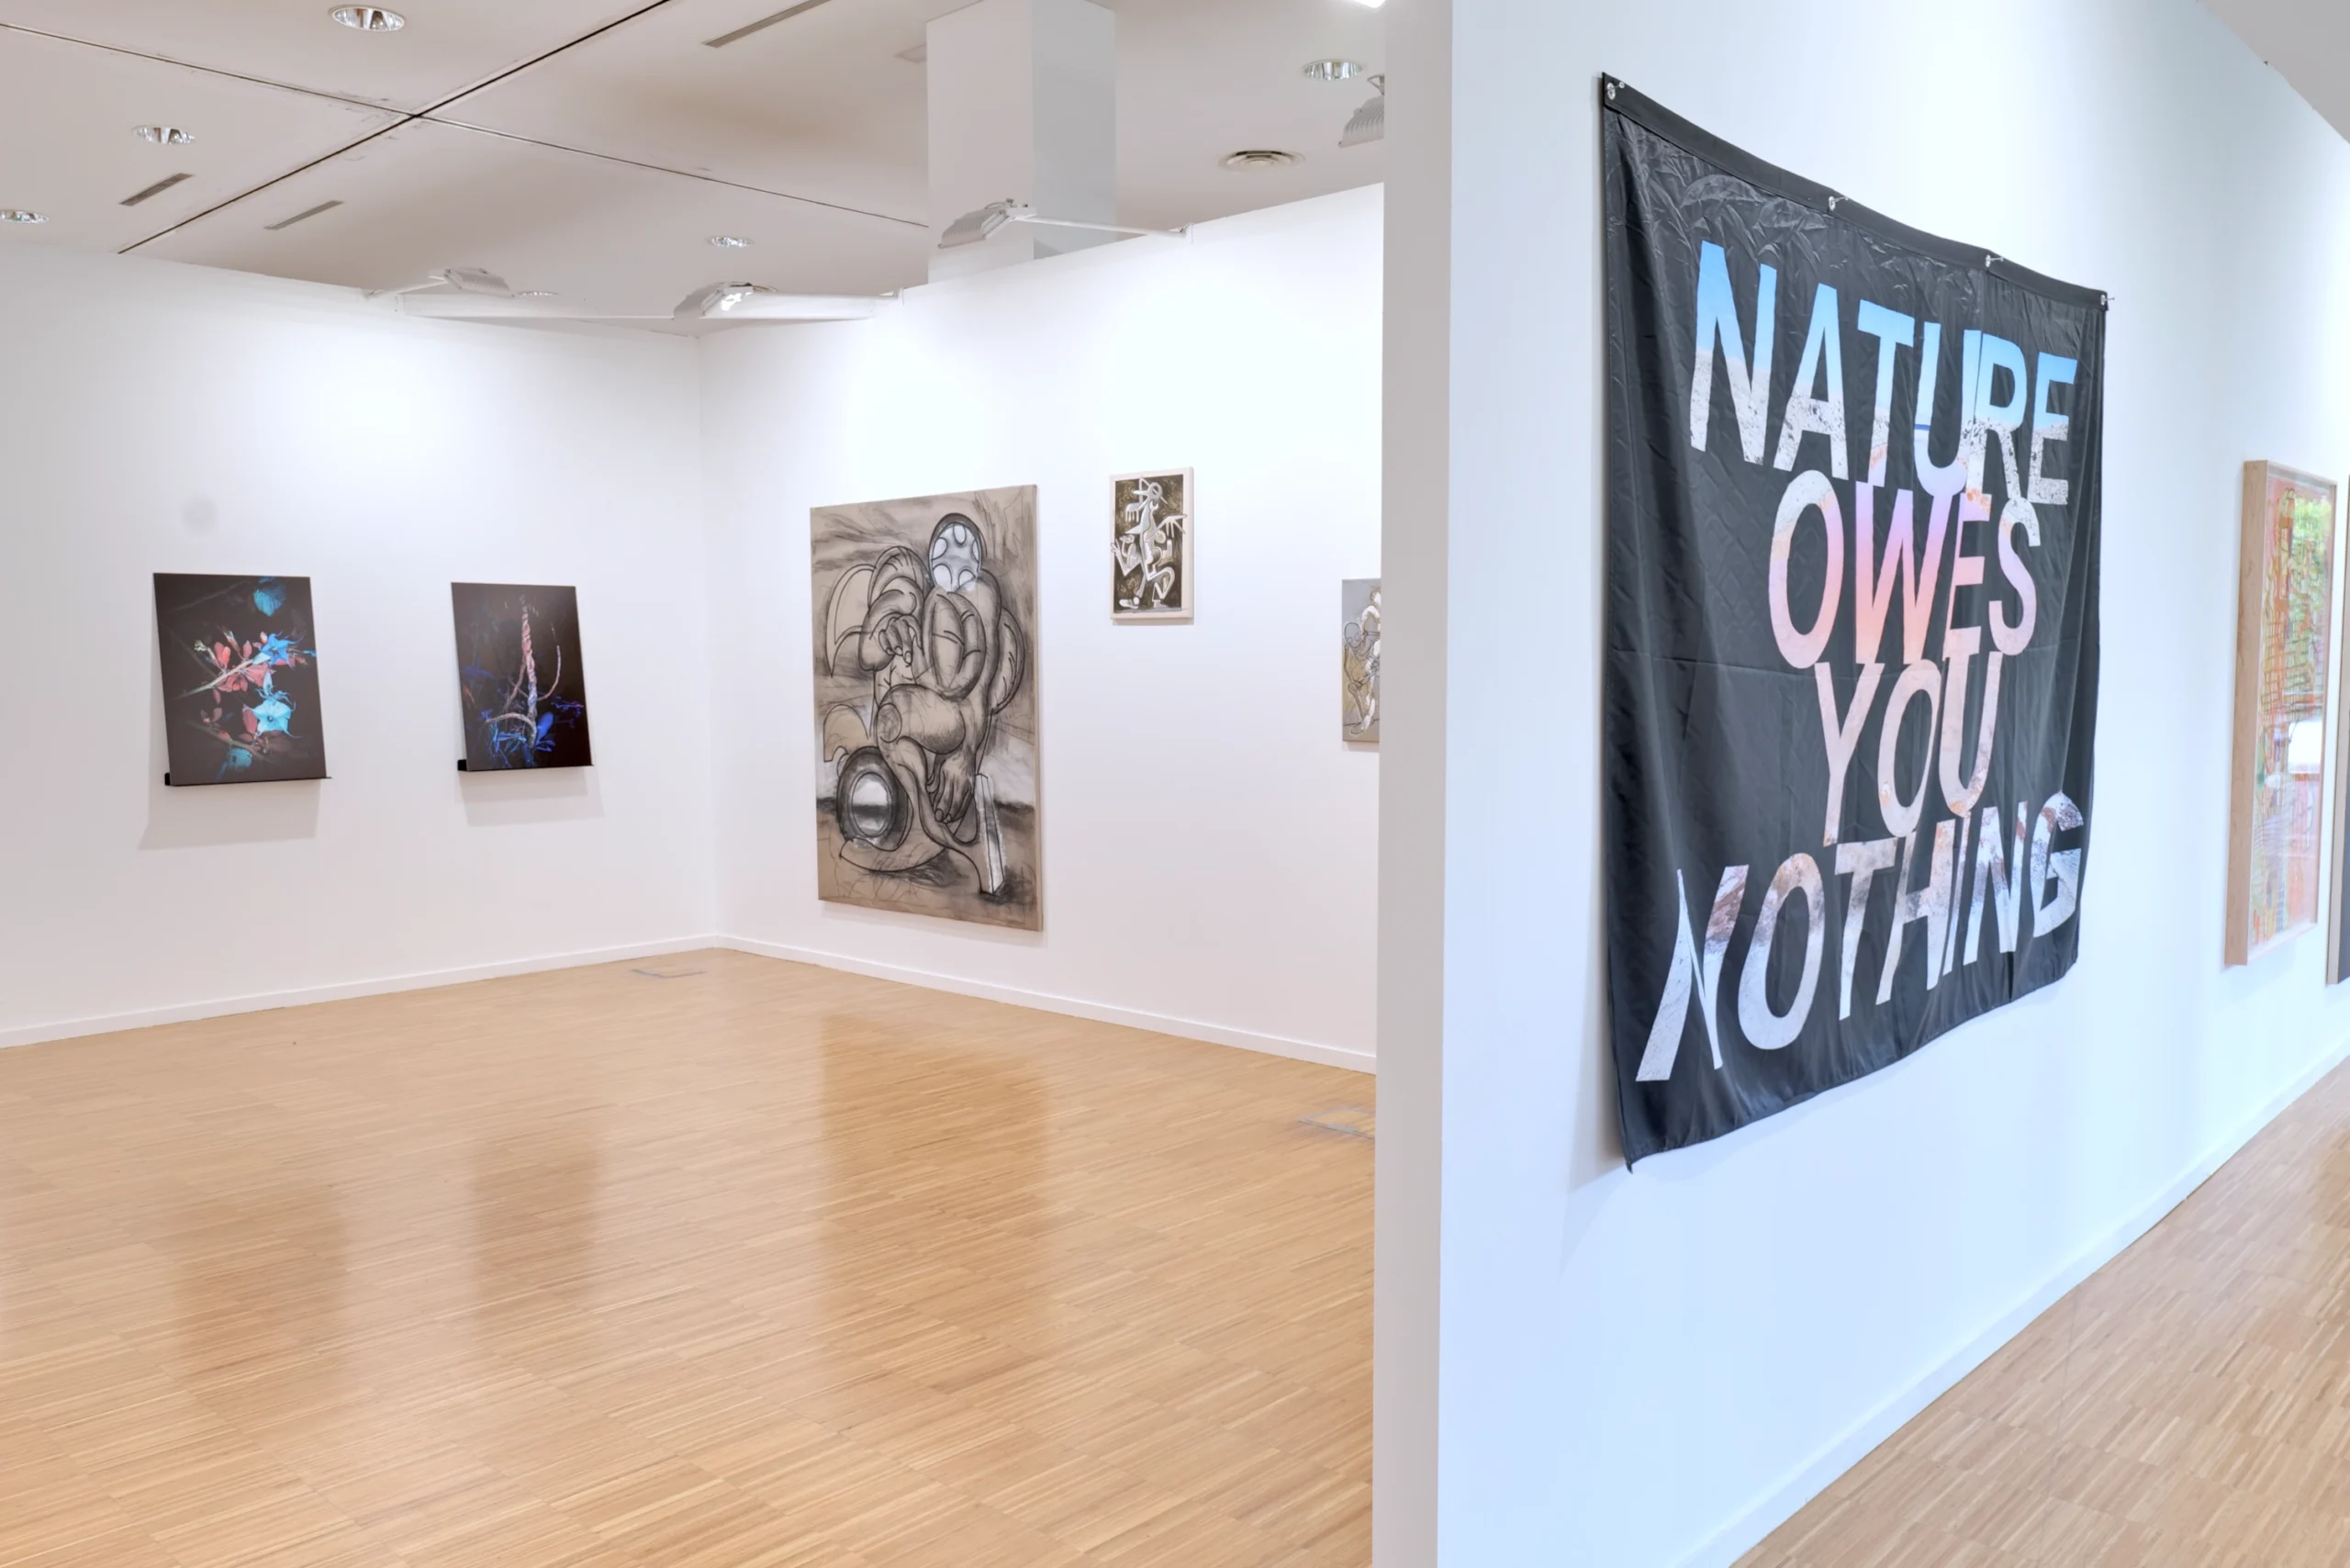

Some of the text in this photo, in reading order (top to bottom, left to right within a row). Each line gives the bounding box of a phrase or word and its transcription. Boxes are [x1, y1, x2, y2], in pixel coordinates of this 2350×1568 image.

[1689, 240, 2077, 505] NATURE
[1769, 469, 2041, 668] OWES
[1814, 651, 2002, 846] YOU
[1635, 790, 2084, 1081] NOTHING
